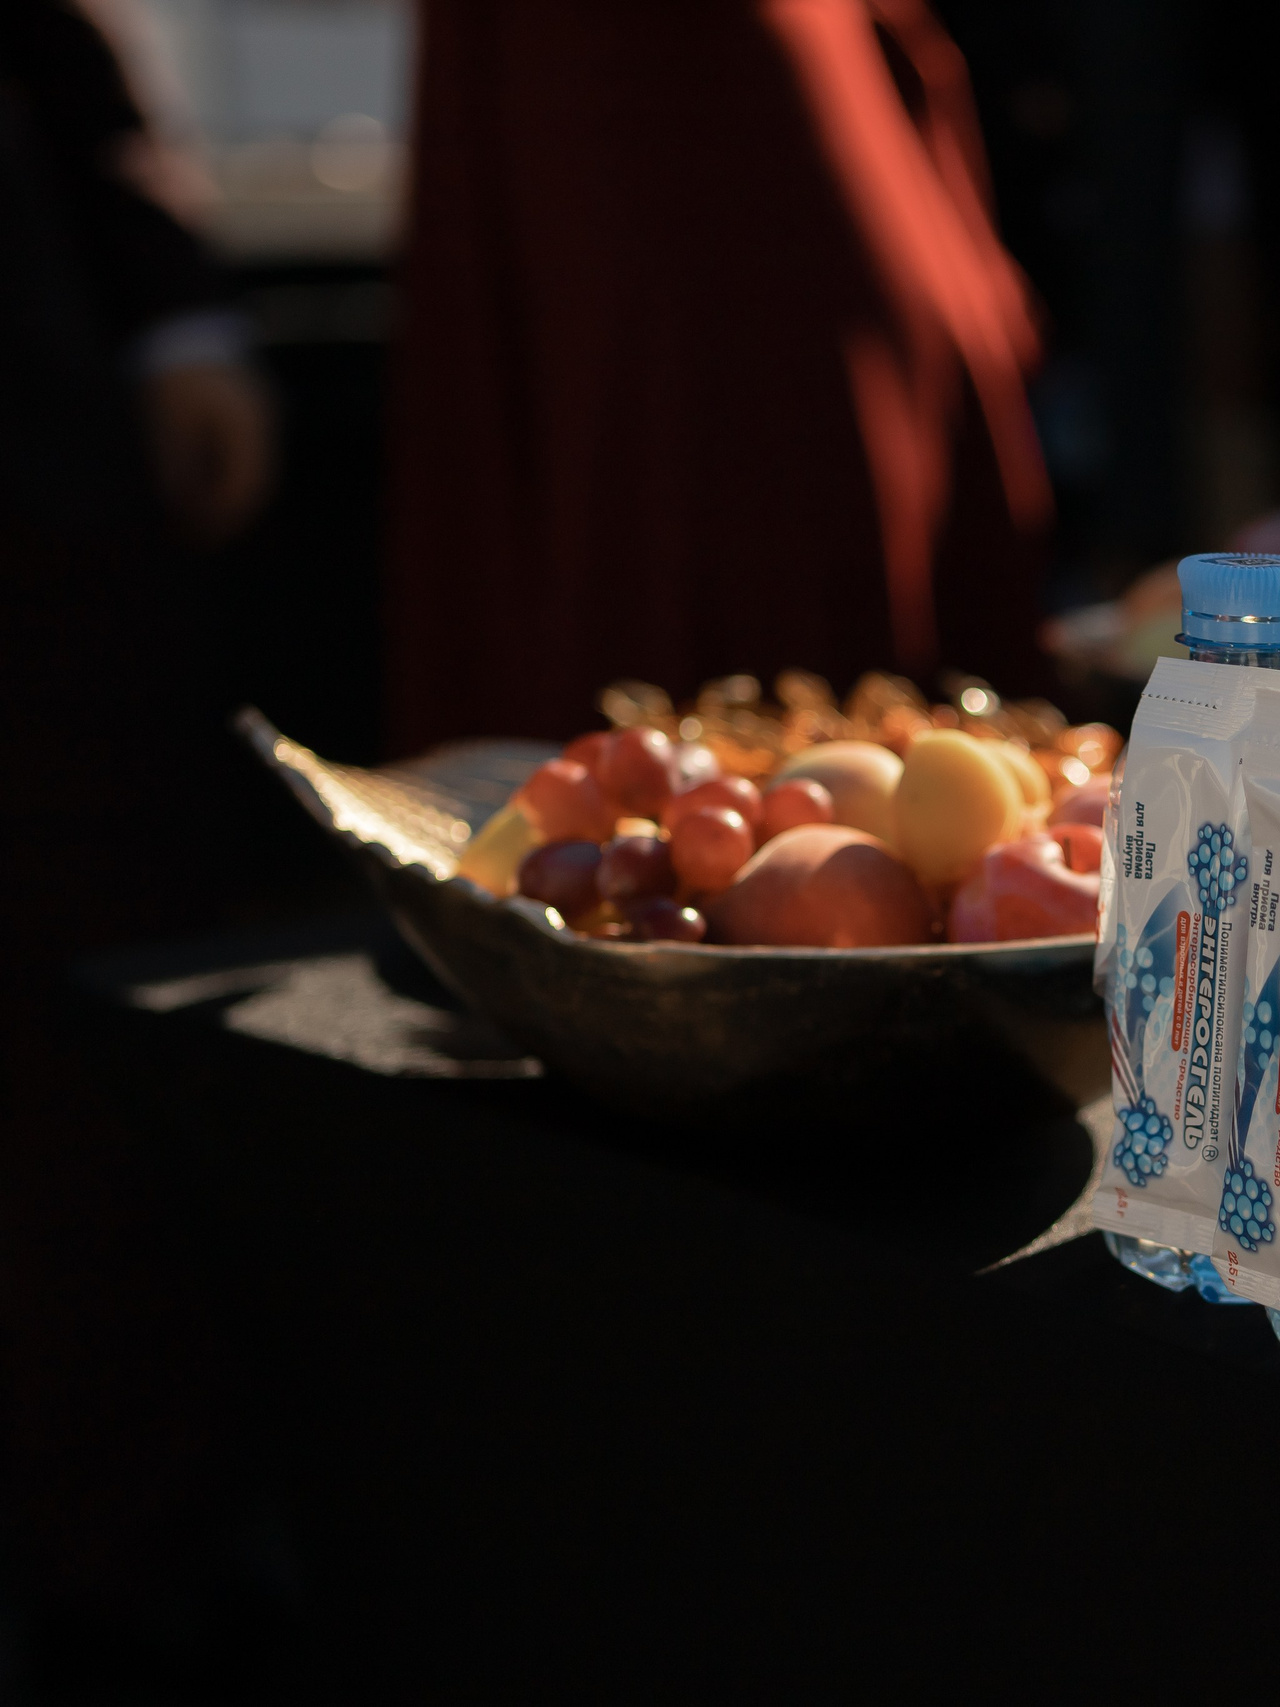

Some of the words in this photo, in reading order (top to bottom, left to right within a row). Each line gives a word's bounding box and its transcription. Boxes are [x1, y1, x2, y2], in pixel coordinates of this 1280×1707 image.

[1136, 801, 1145, 827] для
[1123, 835, 1133, 878] внутрь
[1134, 830, 1144, 880] приема
[1145, 842, 1156, 880] Паста
[1264, 849, 1273, 876] для
[1250, 883, 1260, 928] внутрь
[1259, 879, 1270, 930] приема
[1268, 892, 1280, 932] Паста
[1182, 912, 1201, 1055] Энтеросорбирующее
[1214, 922, 1232, 1063] Полиметилсилоксана
[1184, 915, 1217, 1149] ЭНТЕРОСГЕЛЬ
[1174, 1058, 1187, 1121] средство
[1208, 1066, 1222, 1142] полигидрат
[1227, 1249, 1239, 1277] 22,5
